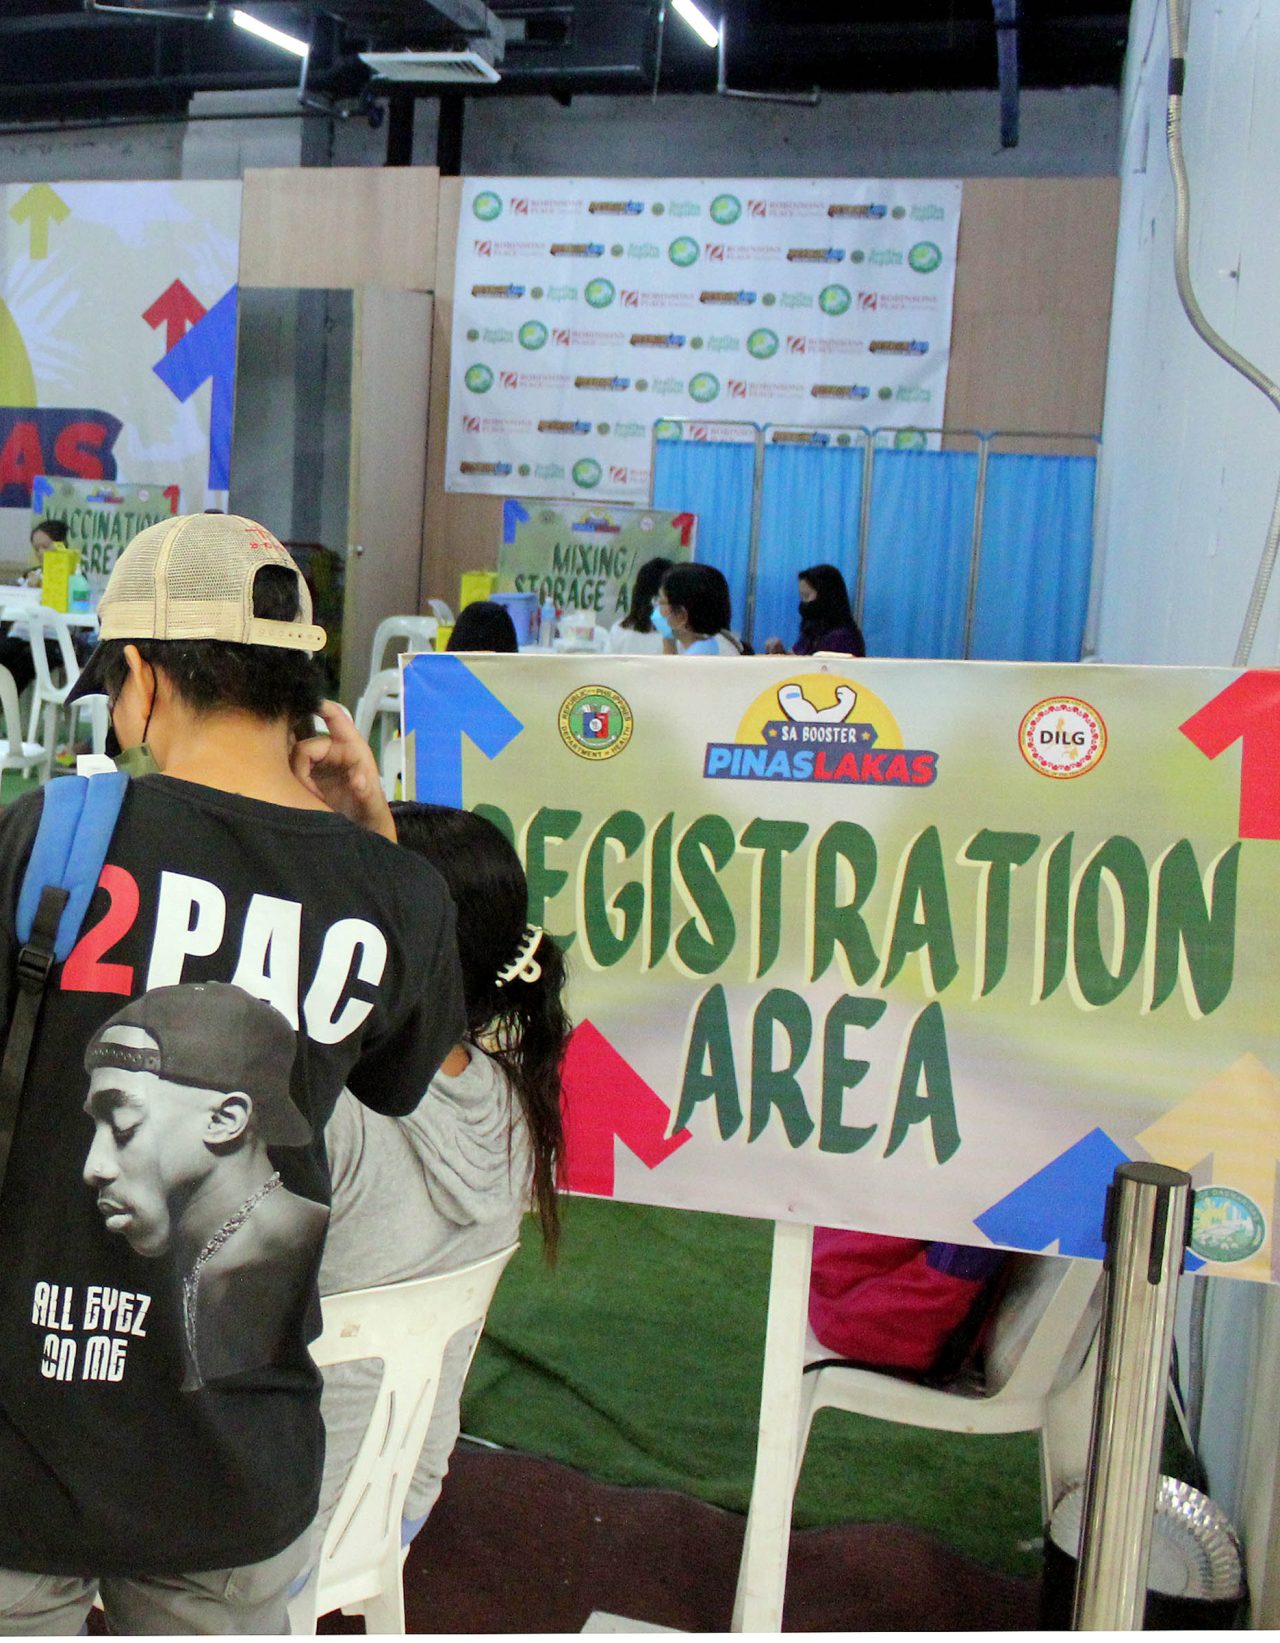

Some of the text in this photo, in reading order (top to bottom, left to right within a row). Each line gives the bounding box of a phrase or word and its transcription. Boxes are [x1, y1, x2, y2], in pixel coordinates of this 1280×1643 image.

[781, 725, 857, 744] SA BOOSTER
[1040, 730, 1085, 746] DILG
[707, 746, 935, 785] PINASLAKAS
[472, 803, 1242, 1018] EGISTRATION
[60, 863, 388, 1046] 2PAC
[670, 983, 962, 1166] AREA
[31, 1281, 152, 1338] ALL EYEZ
[41, 1333, 129, 1383] ON ME
